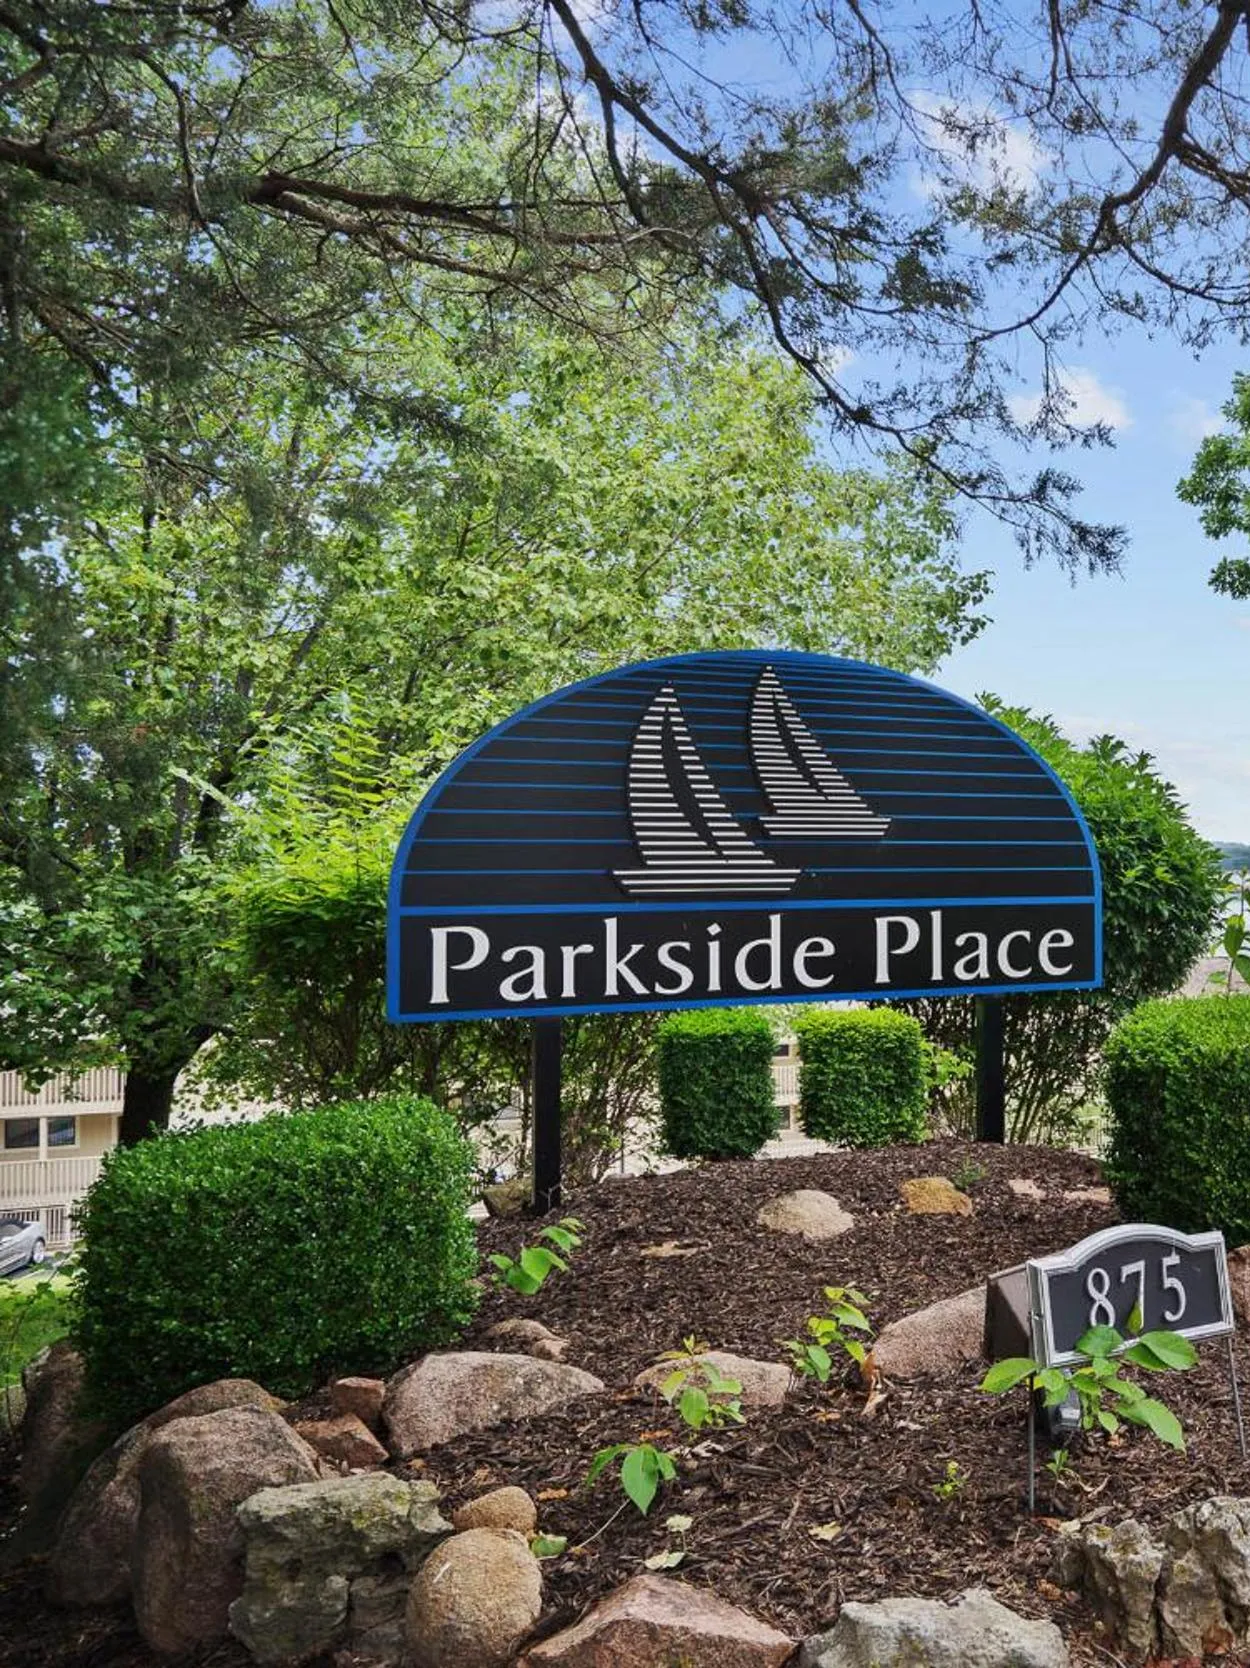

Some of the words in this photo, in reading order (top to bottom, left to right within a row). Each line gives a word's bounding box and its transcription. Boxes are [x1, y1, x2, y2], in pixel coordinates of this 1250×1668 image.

[428, 913, 836, 1003] Parkside
[874, 910, 1075, 983] Place
[1086, 1250, 1187, 1329] 875
